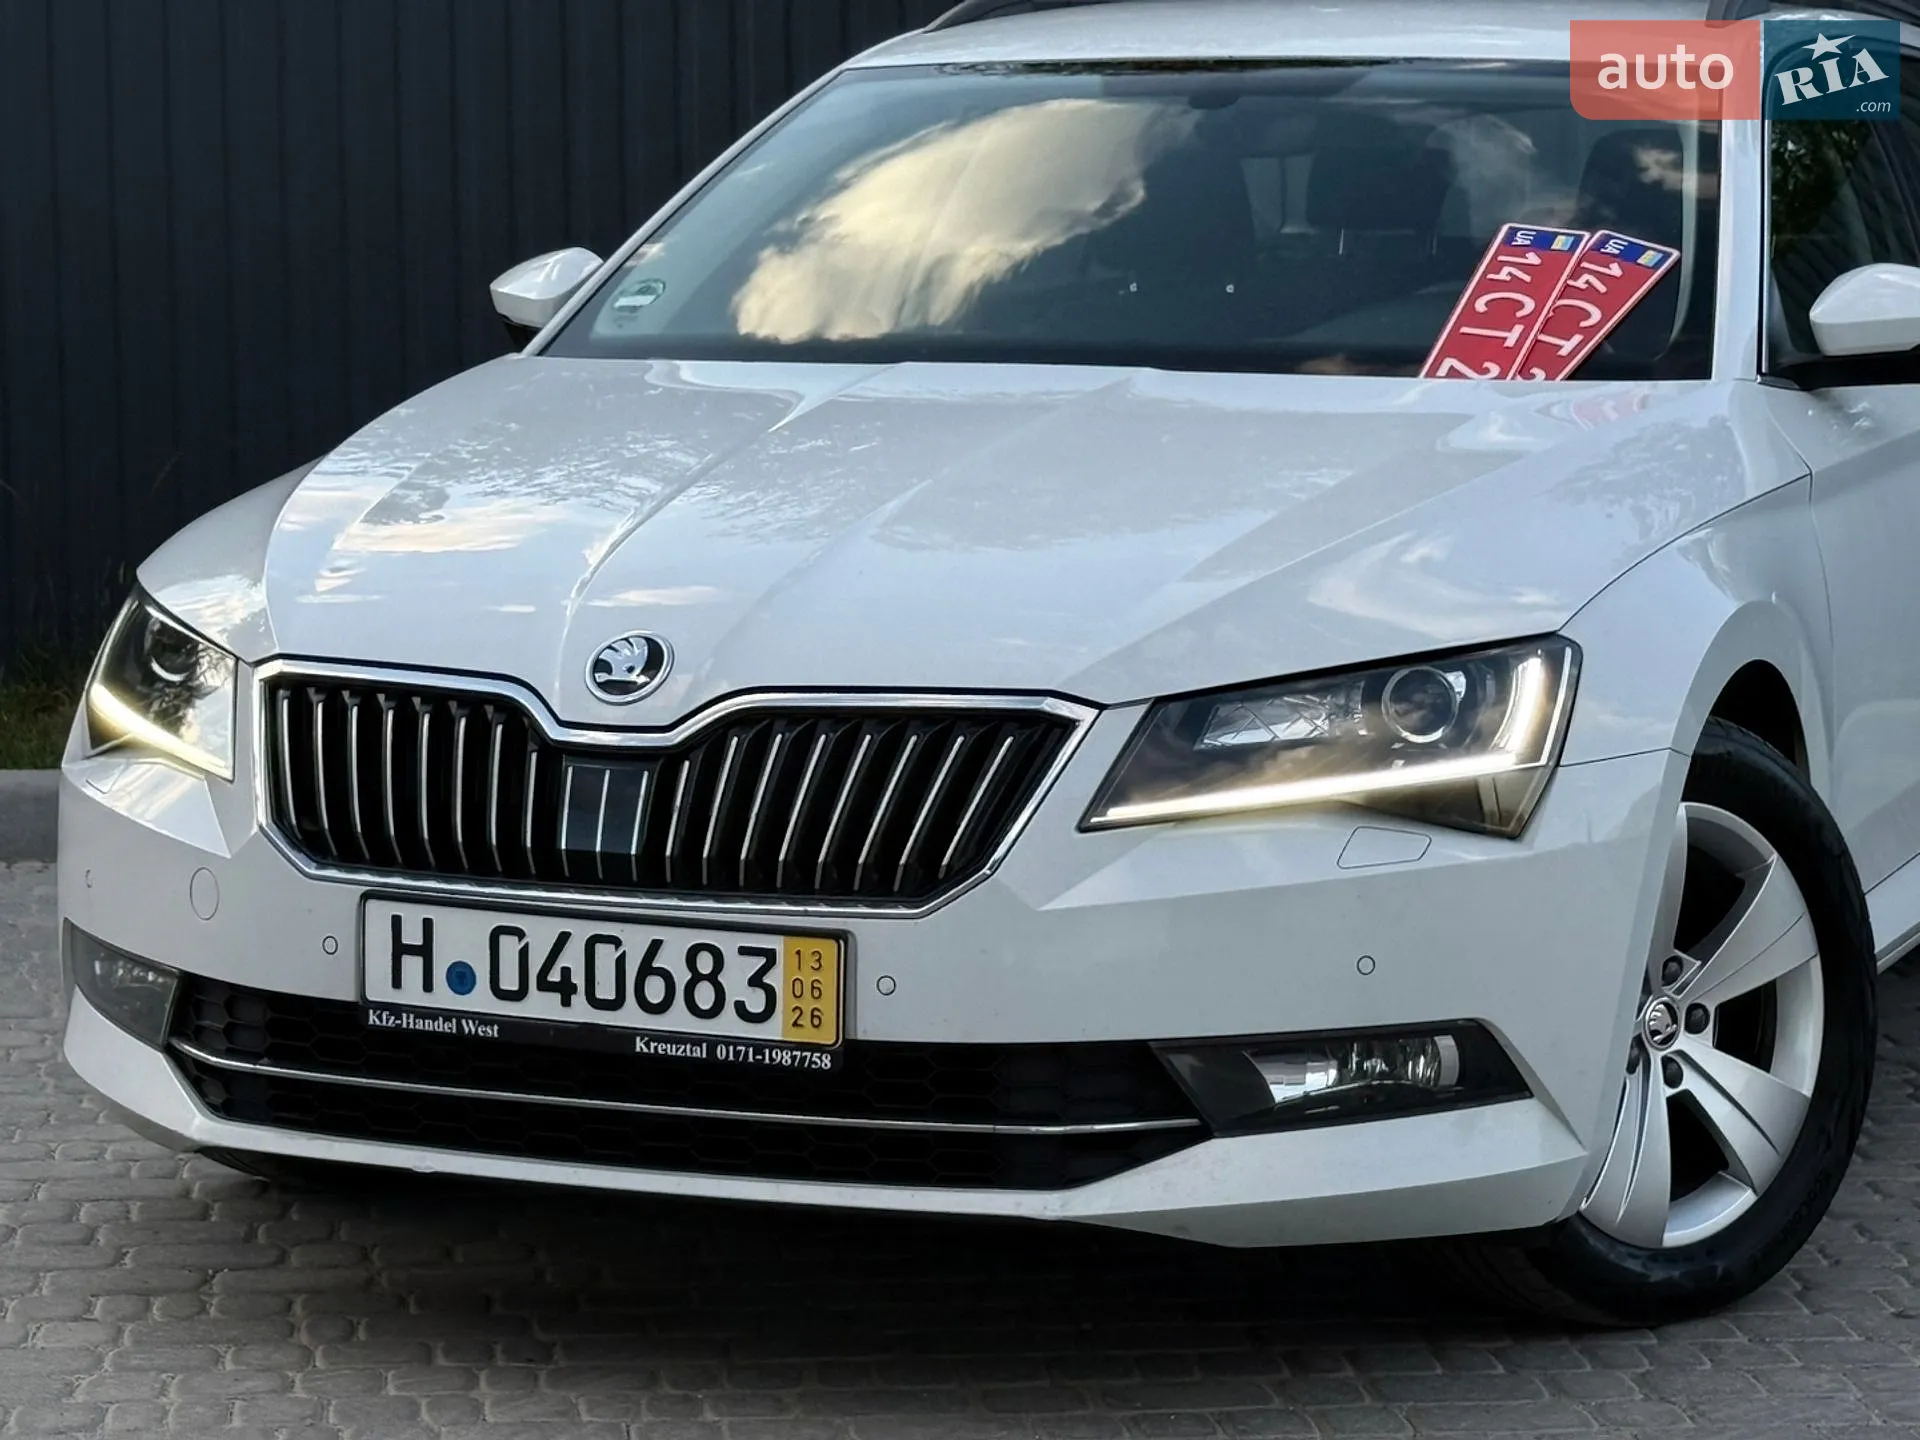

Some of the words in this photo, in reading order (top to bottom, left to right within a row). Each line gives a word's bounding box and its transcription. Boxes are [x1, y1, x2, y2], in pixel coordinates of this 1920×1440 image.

[1512, 230, 1536, 247] UA
[1601, 238, 1628, 255] UA
[390, 914, 434, 993] H
[489, 925, 778, 1025] 040683
[795, 949, 823, 972] 13
[792, 977, 823, 1000] 06
[368, 1009, 456, 1034] Kfz-Handel
[461, 1019, 500, 1038] West
[791, 1005, 824, 1029] 26
[635, 1036, 707, 1059] Kreuztal
[716, 1044, 832, 1070] 0171-1987758
